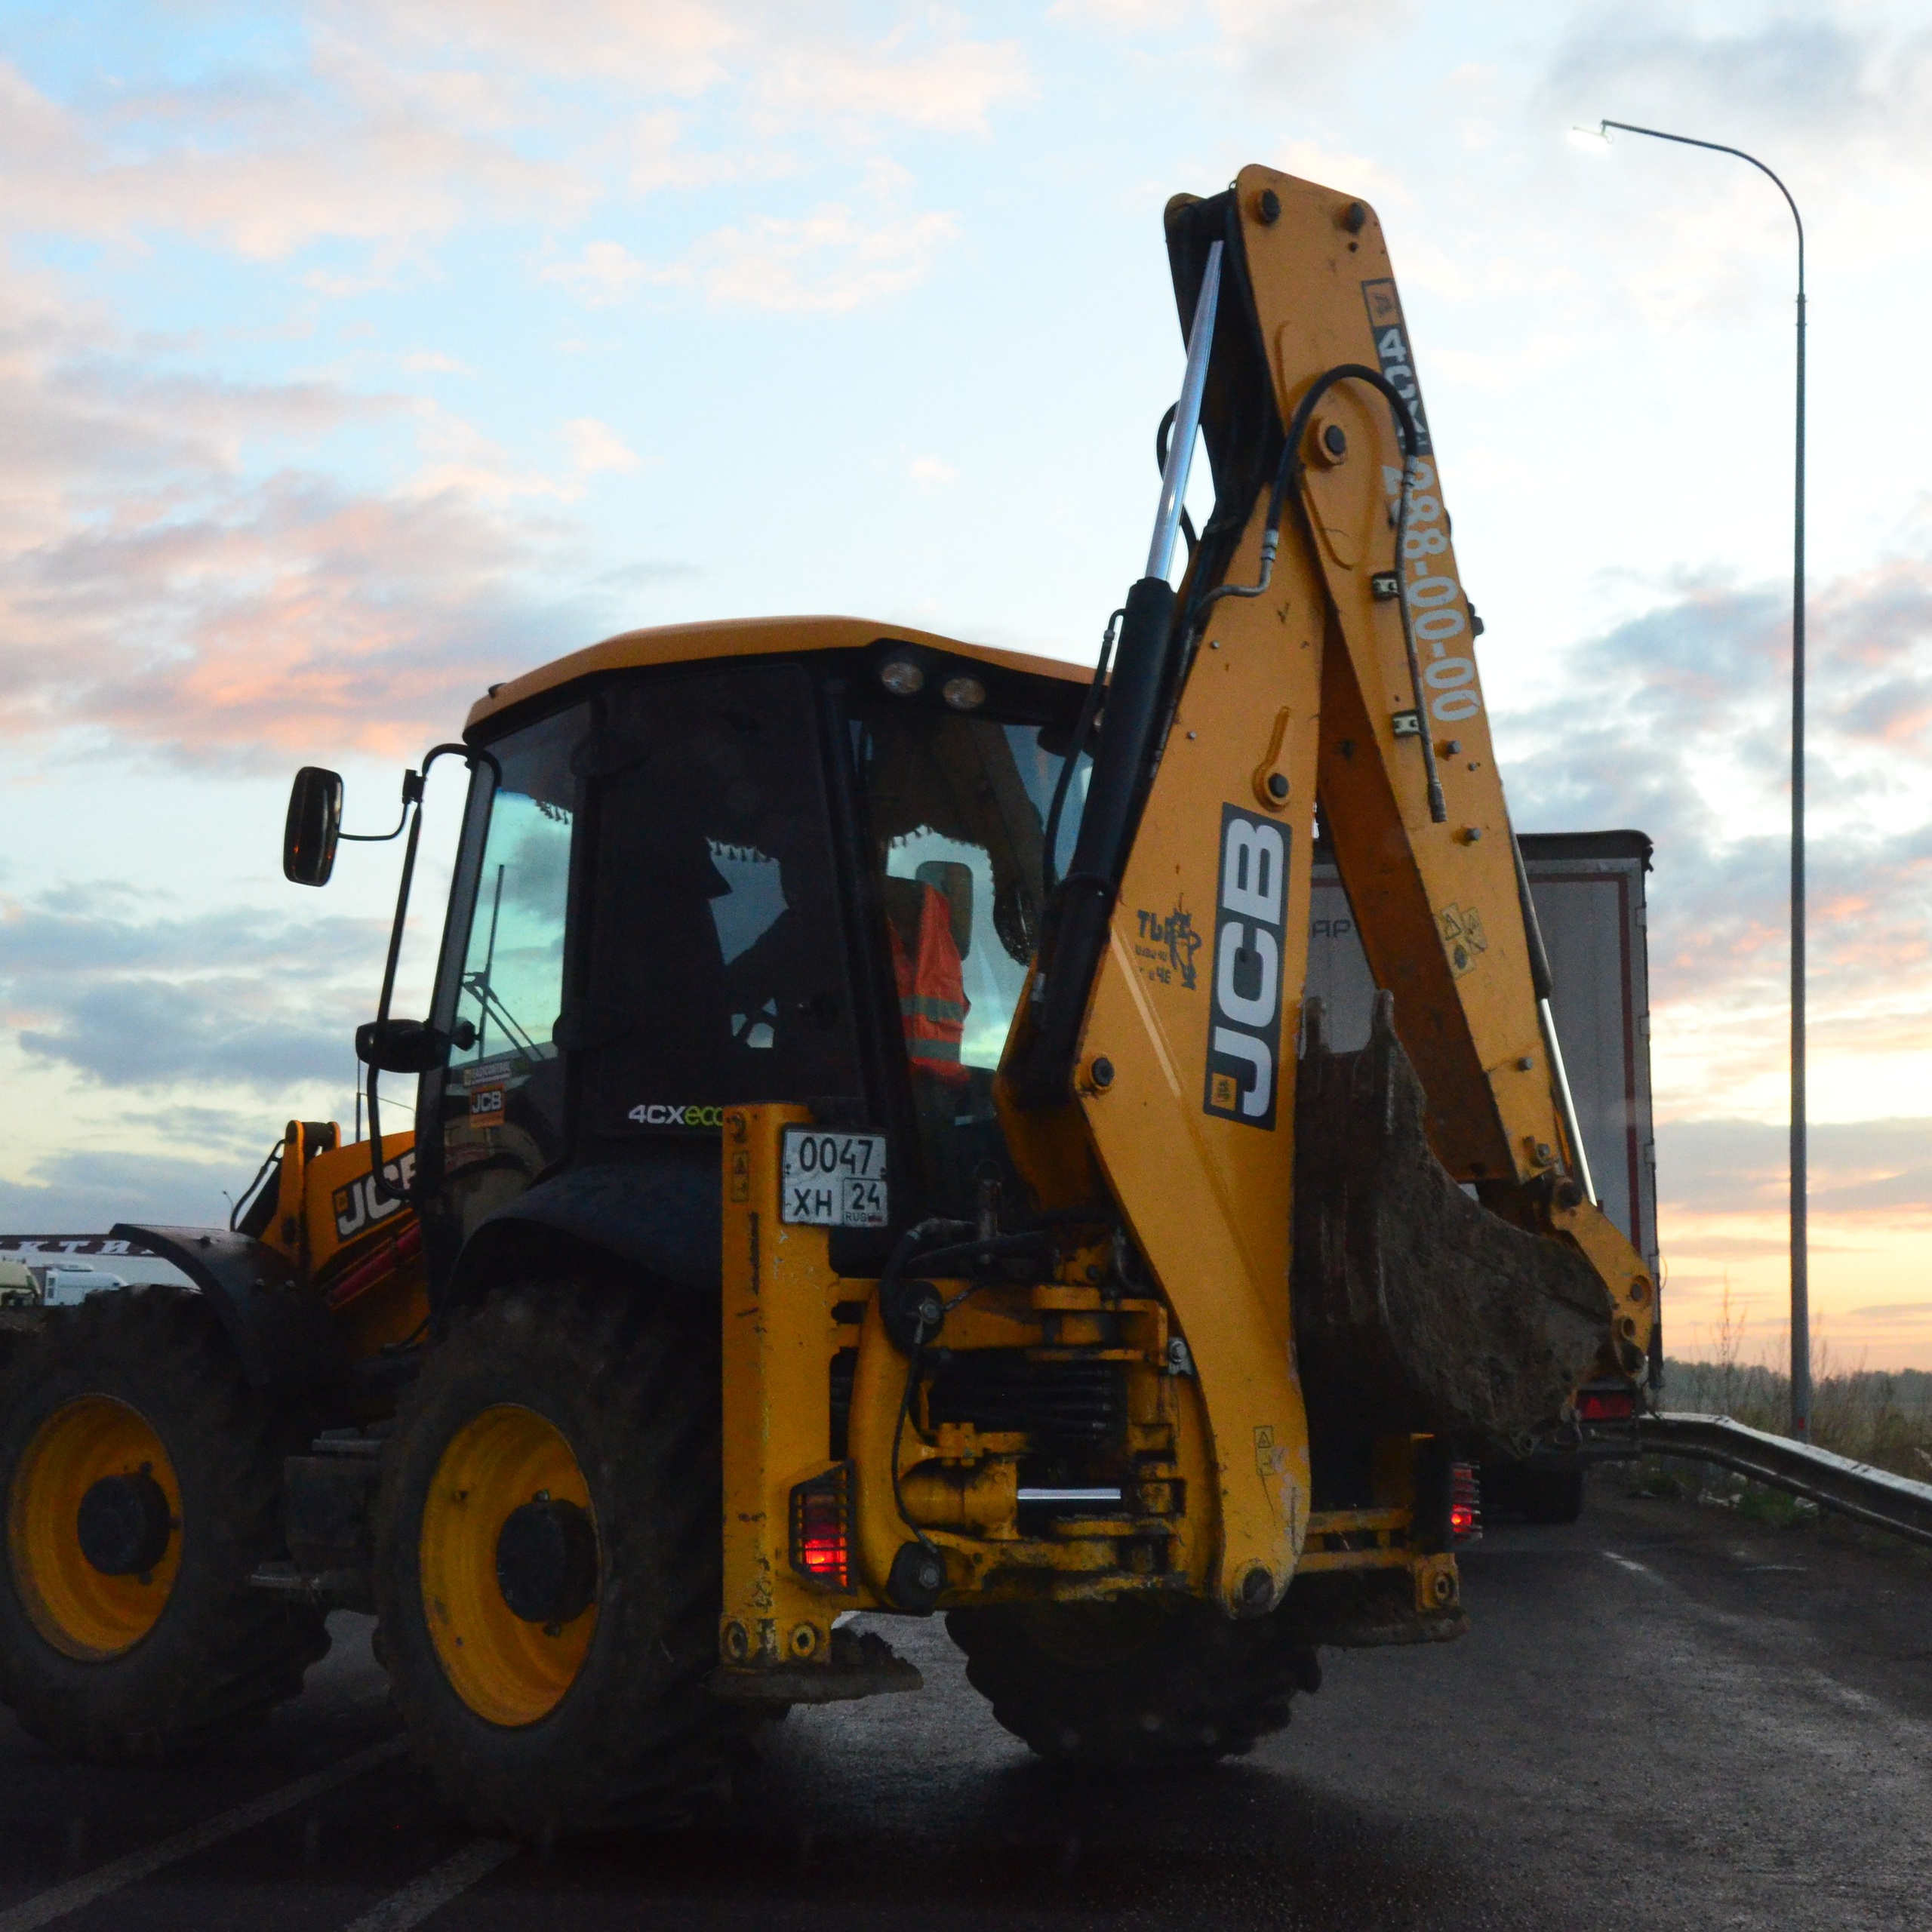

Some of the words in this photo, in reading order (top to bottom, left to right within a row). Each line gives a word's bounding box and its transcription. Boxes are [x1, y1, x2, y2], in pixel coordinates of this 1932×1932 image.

[1214, 817, 1285, 1118] JCB
[472, 1090, 502, 1113] JCB
[799, 1137, 873, 1174] 0047
[852, 1183, 881, 1211] 24
[845, 1212, 867, 1223] RUS
[0, 1240, 156, 1254] КТИ
